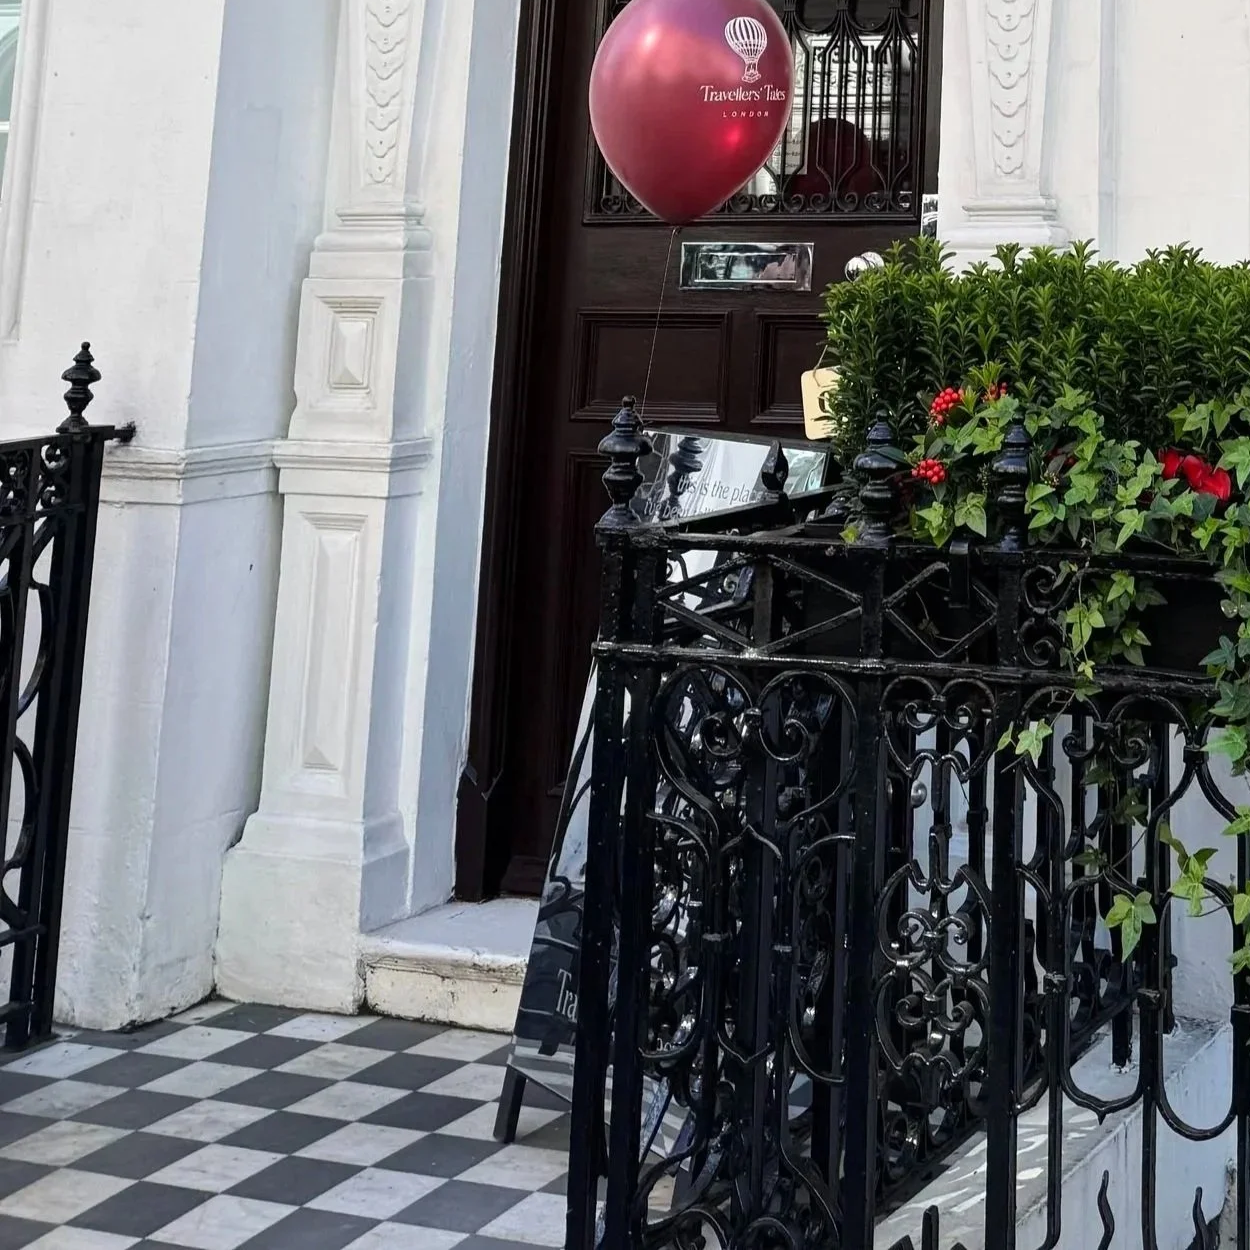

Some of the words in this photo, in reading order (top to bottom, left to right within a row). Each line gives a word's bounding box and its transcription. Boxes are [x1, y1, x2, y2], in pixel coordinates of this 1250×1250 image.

[764, 84, 786, 101] Tales
[722, 110, 769, 118] LONDON
[711, 480, 730, 500] the
